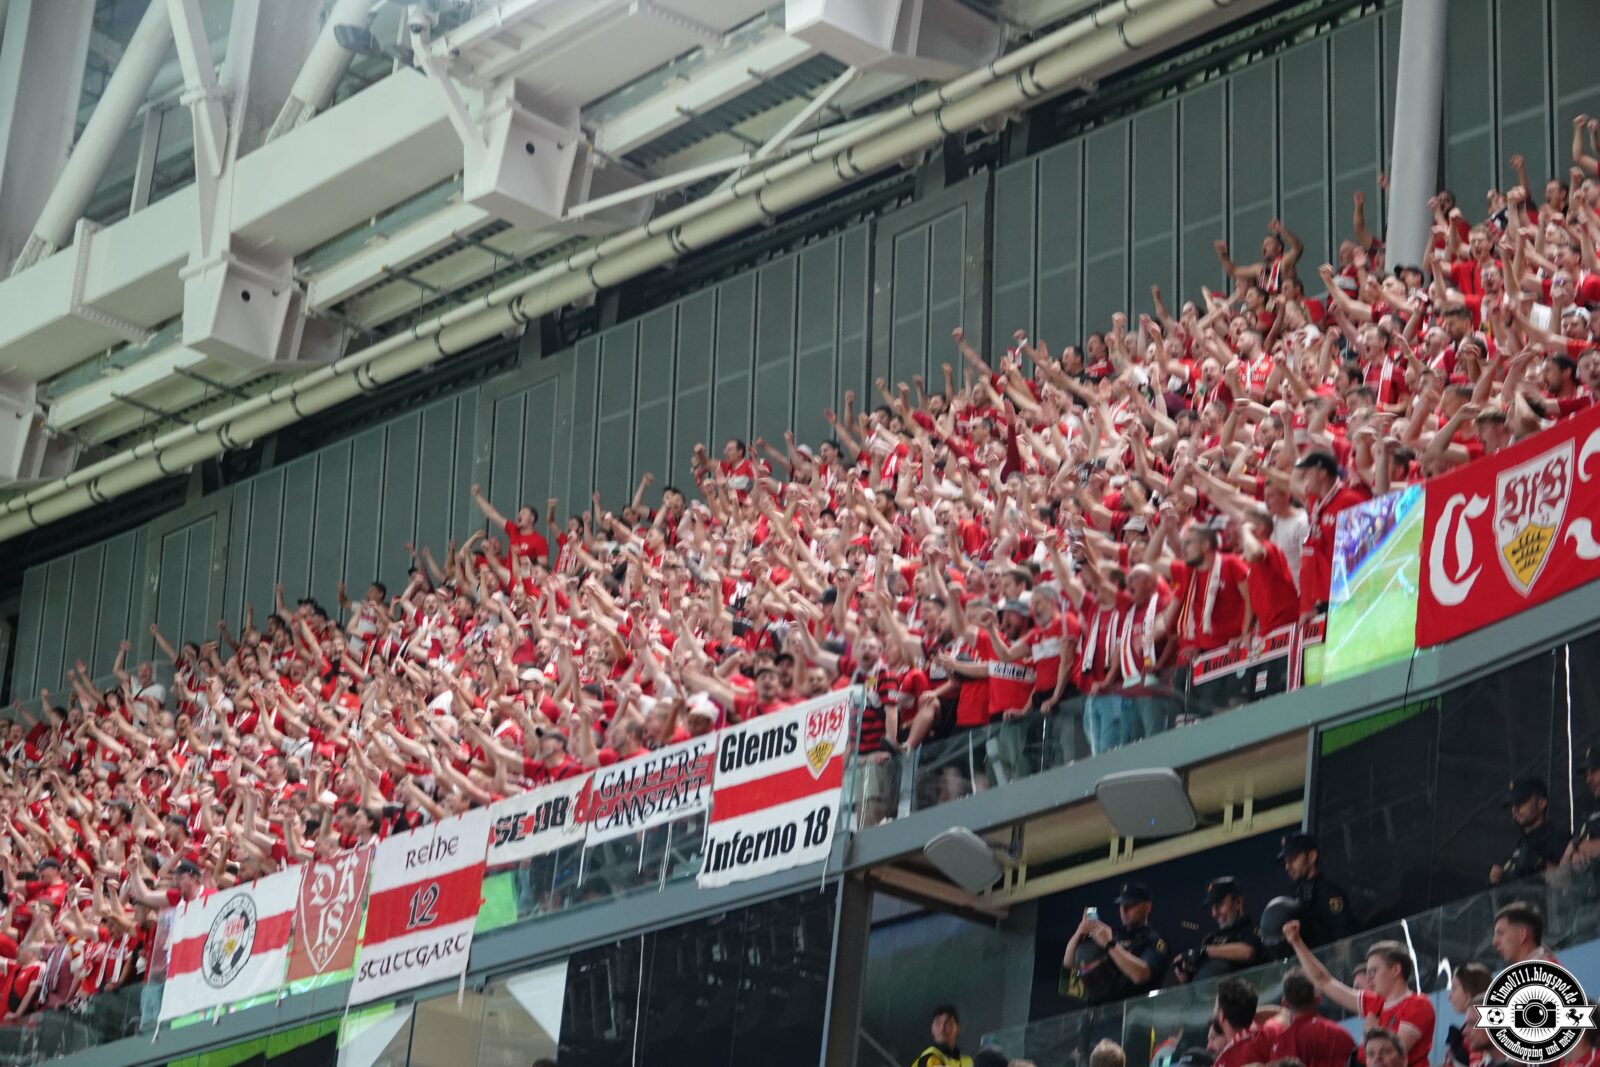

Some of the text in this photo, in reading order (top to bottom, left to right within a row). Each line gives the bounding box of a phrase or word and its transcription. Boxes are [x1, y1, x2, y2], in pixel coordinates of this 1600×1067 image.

[600, 743, 709, 799] GALEERE
[719, 721, 799, 773] Glems
[594, 776, 706, 832] CANNSTATT
[704, 806, 831, 874] Inferno 18
[405, 882, 440, 929] 12
